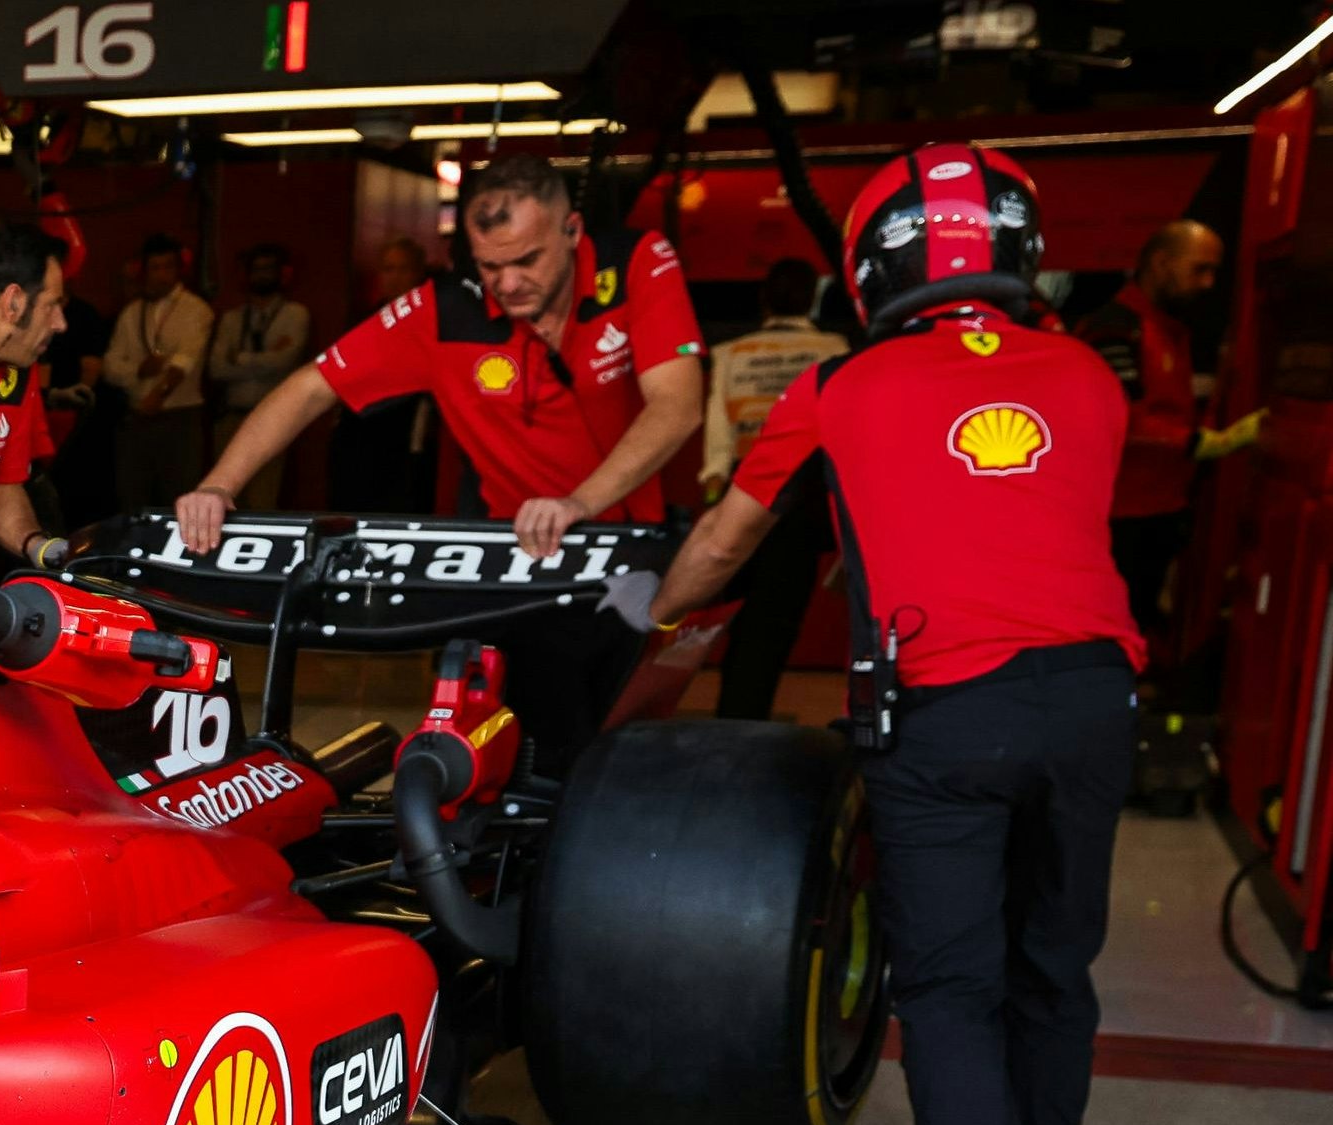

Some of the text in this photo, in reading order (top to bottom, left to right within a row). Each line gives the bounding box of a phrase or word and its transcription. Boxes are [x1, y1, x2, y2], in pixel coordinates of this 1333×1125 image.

[24, 5, 156, 82] 16
[152, 690, 230, 778] 16
[157, 762, 304, 830] Santander
